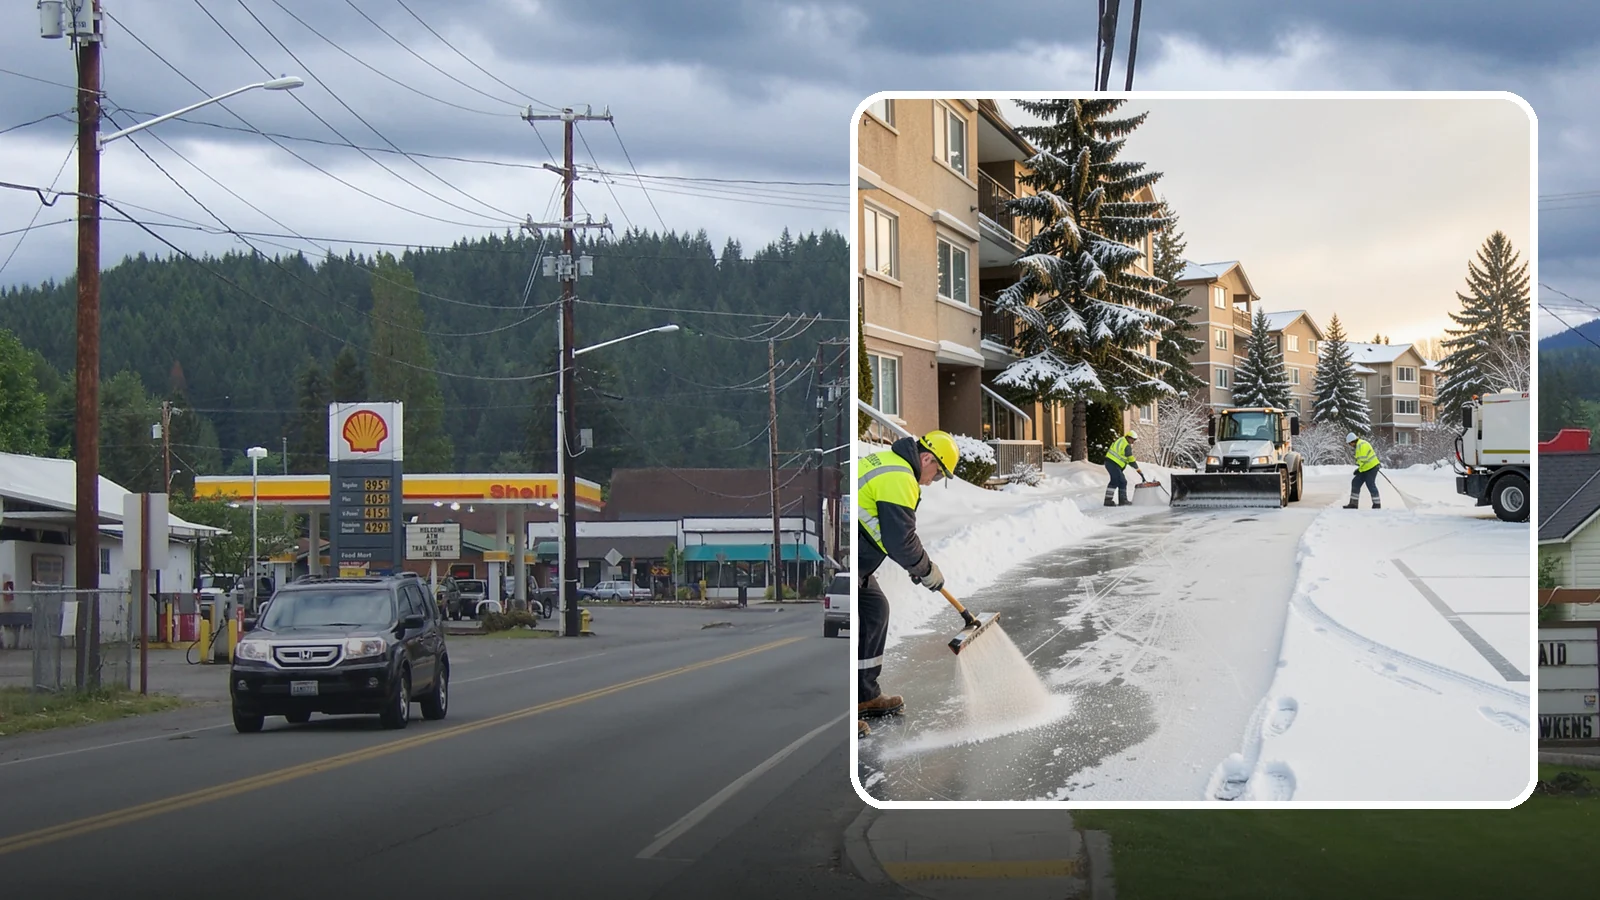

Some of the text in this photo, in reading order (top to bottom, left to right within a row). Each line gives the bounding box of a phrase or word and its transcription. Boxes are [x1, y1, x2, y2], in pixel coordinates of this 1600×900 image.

[365, 480, 383, 490] 395
[490, 484, 547, 498] Shell
[365, 494, 383, 504] 405
[365, 508, 383, 518] 415
[365, 522, 383, 532] 429
